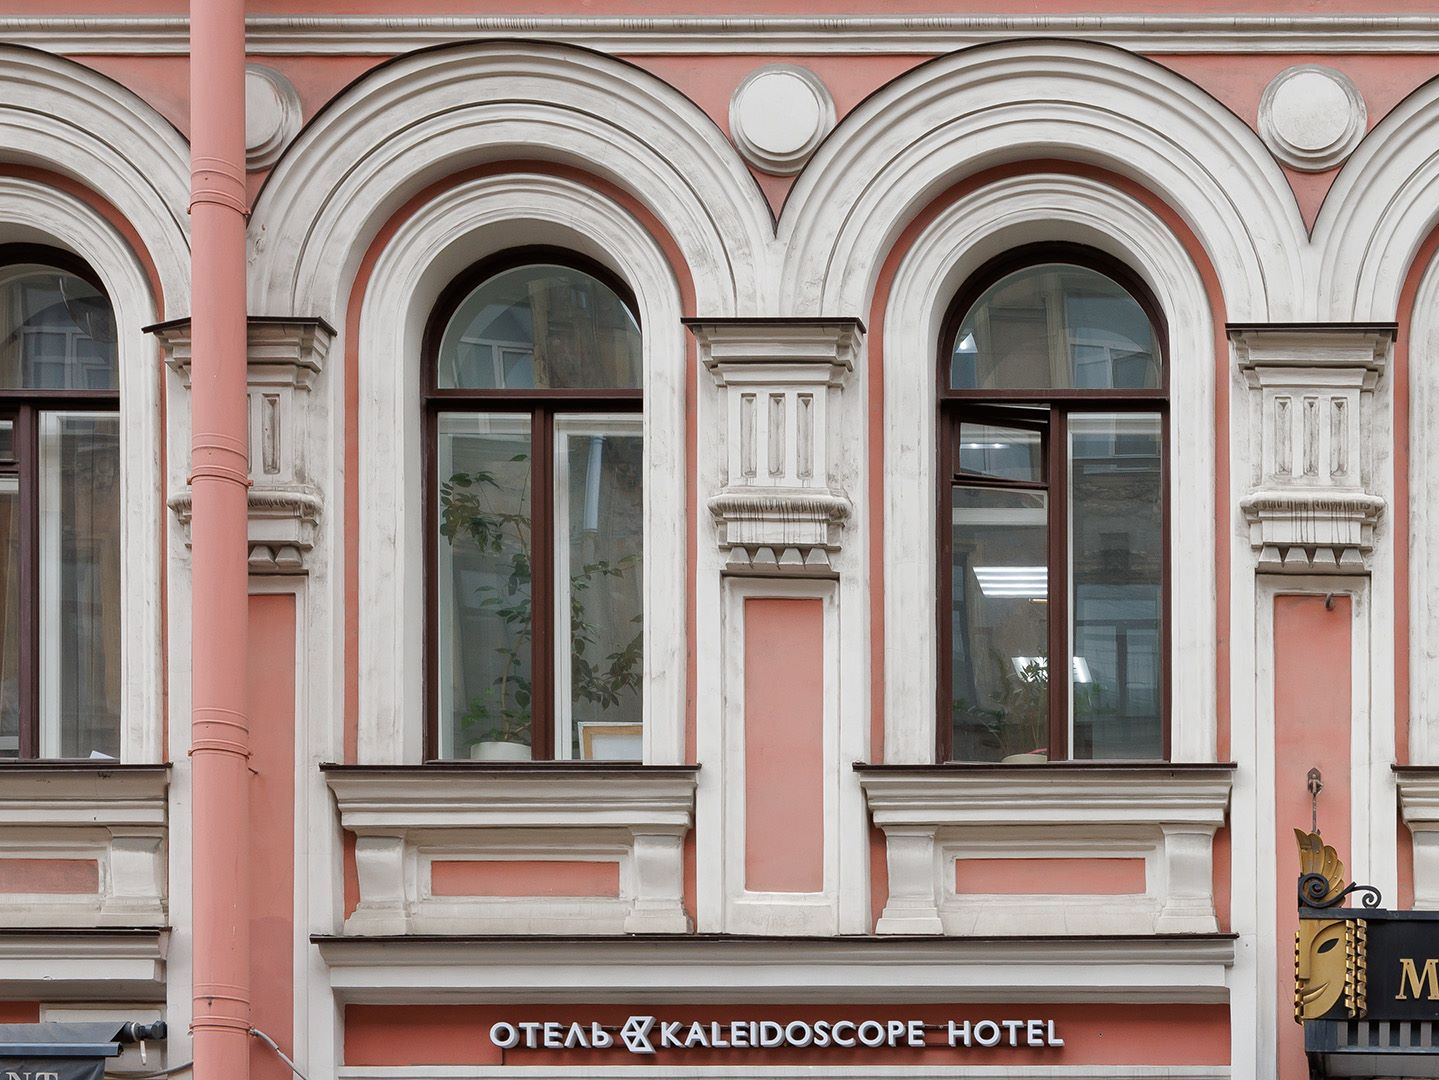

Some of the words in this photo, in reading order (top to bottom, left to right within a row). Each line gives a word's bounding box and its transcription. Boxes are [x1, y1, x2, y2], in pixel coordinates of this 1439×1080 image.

[489, 1021, 613, 1049] ОТЕЛЬ
[661, 1020, 926, 1048] KALEIDOSCOPE
[947, 1019, 1065, 1047] HOTEL
